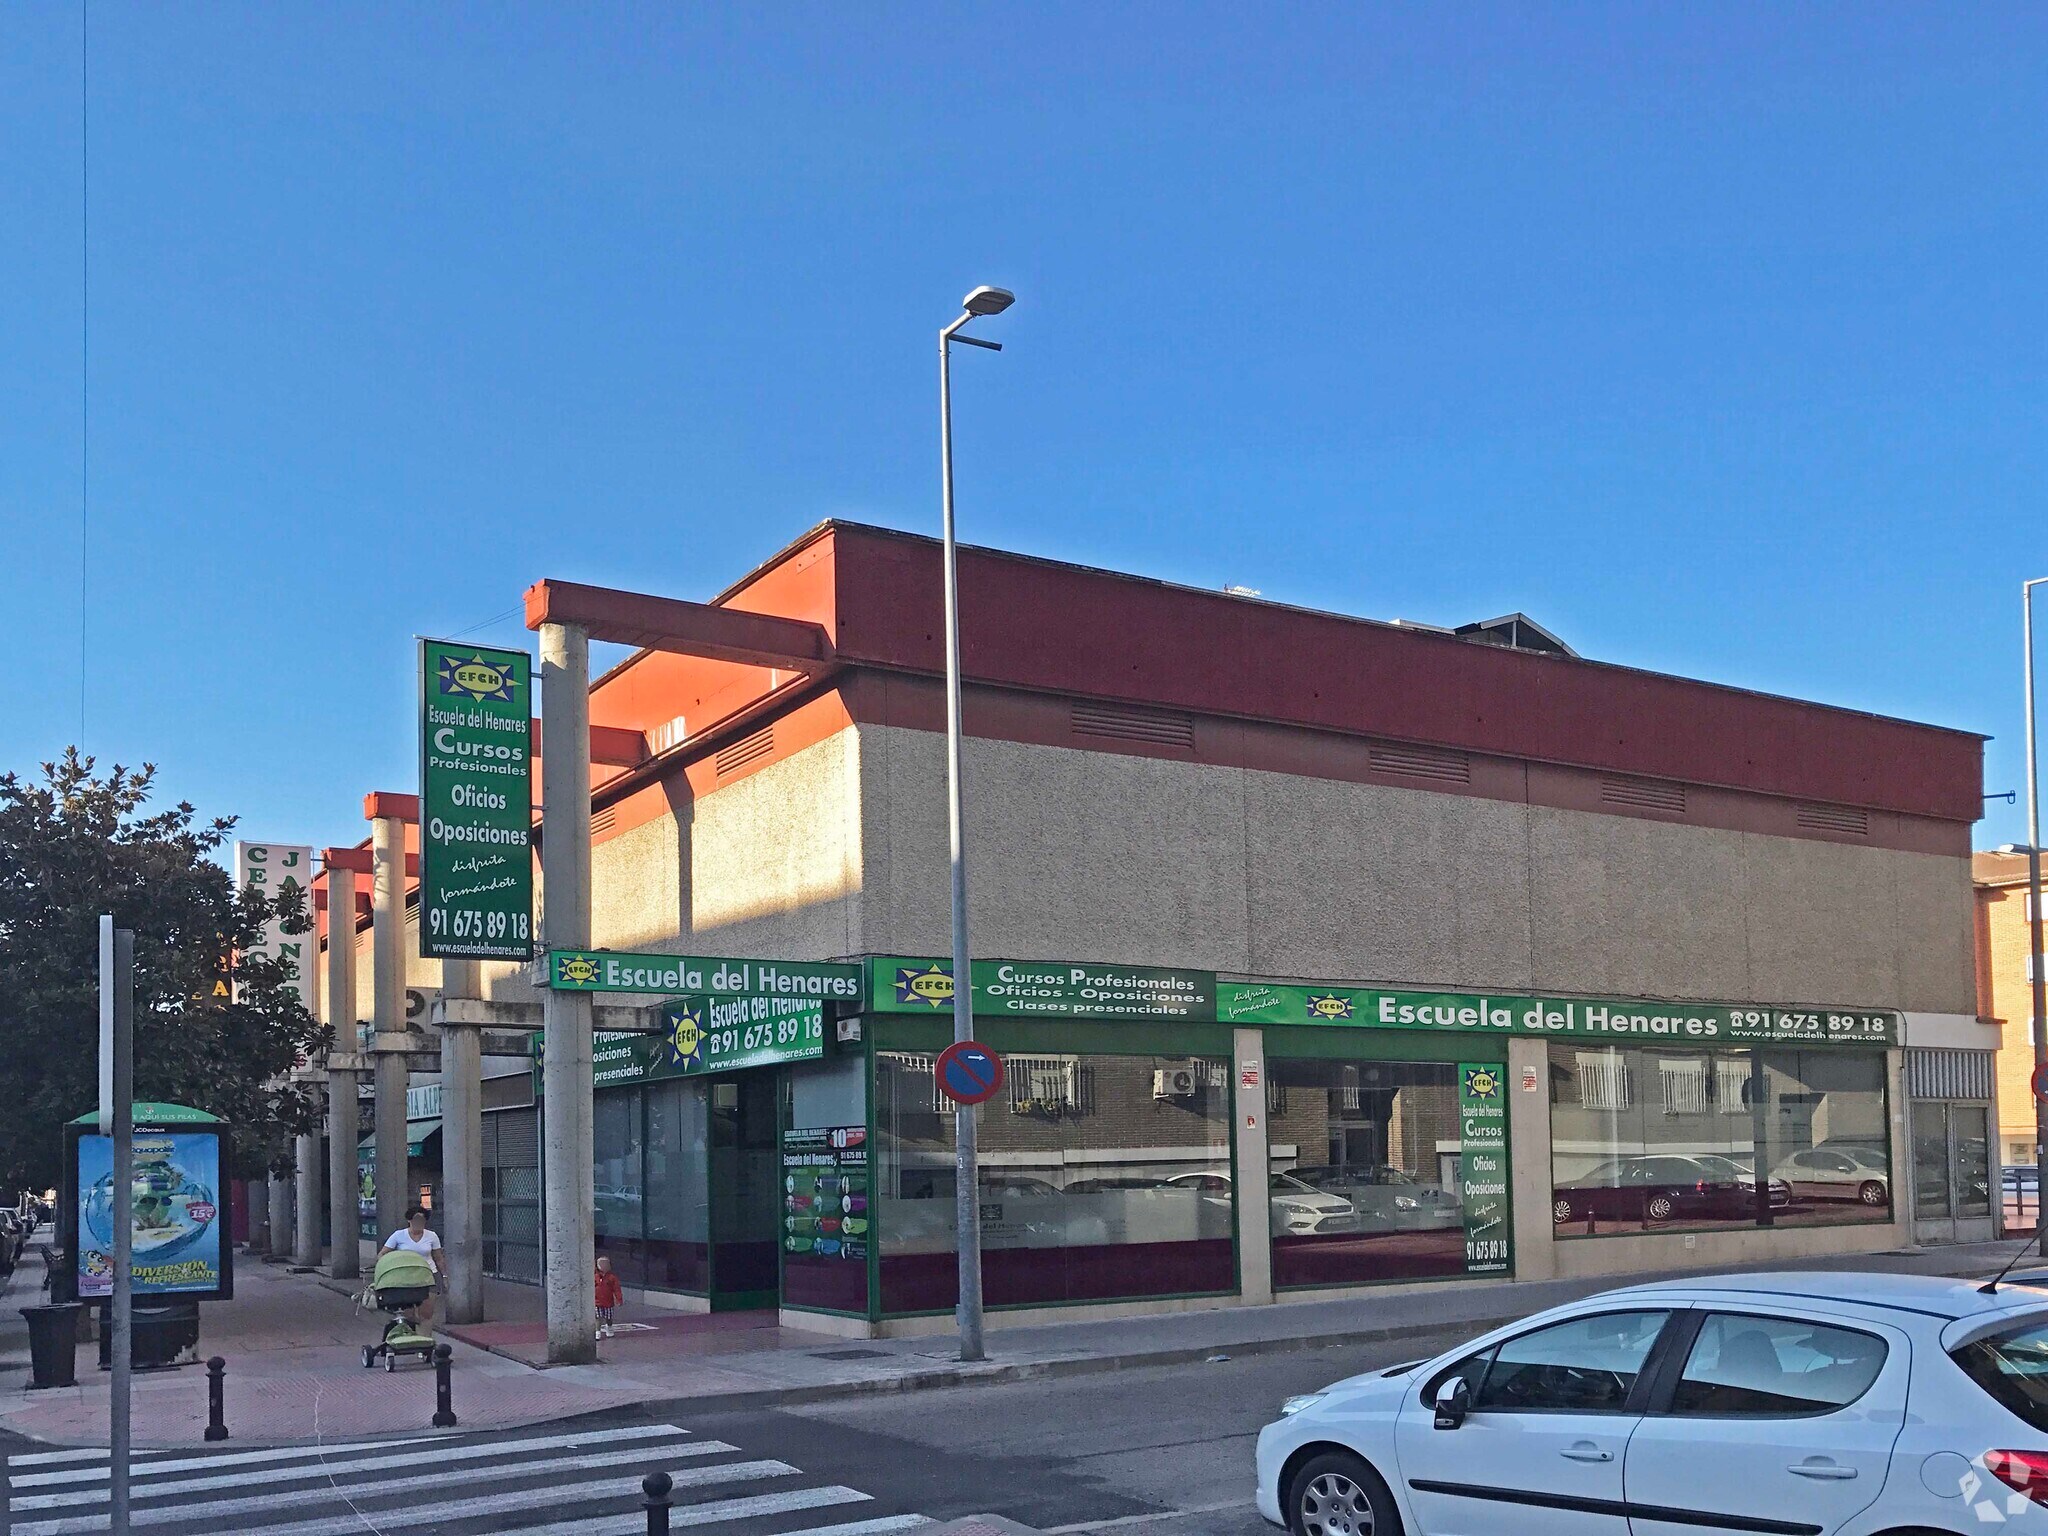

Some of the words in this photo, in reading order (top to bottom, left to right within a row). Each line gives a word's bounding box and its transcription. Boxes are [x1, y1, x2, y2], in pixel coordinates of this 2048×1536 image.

[458, 671, 499, 685] EFCH
[429, 704, 465, 726] Escuela
[467, 707, 483, 728] del
[485, 711, 527, 733] Henares
[434, 727, 523, 761] Cursos
[429, 756, 527, 776] Profesionales
[451, 784, 506, 810] Oficios
[429, 817, 528, 846] Oposiciones
[452, 854, 507, 873] disfruta
[440, 876, 517, 904] formándote
[430, 907, 448, 936] 91
[453, 909, 483, 938] 675
[486, 911, 507, 938] 89
[511, 912, 529, 940] 18
[432, 941, 527, 956] www.escueladelhenares.com
[568, 966, 591, 974] EFCH
[607, 960, 702, 989] Escuela
[712, 963, 750, 991] del
[759, 966, 858, 996] Henares
[997, 966, 1065, 986] Cursos
[1071, 969, 1195, 991] Profesionales
[986, 985, 1063, 998] Oficios
[1080, 988, 1205, 1004] Oposiciones
[1234, 987, 1271, 1001] disfruta
[709, 998, 748, 1028] Escuela
[751, 997, 769, 1020] del
[1006, 1000, 1068, 1012] Clases
[1073, 1002, 1188, 1016] presenciales
[1379, 997, 1512, 1027] Escuela
[1523, 1003, 1573, 1030] del
[1586, 1007, 1718, 1036] Henares
[1745, 1011, 1770, 1028] 91
[1779, 1013, 1820, 1030] 675
[1828, 1015, 1854, 1031] 89
[1862, 1017, 1885, 1033] 18
[678, 1028, 697, 1043] EFCH
[722, 1031, 738, 1053] 91
[744, 1024, 773, 1050] 675
[778, 1018, 798, 1043] 89
[804, 1014, 823, 1039] 18
[709, 1046, 823, 1069] www.escueladelhenares.com
[593, 1063, 643, 1084] presenciales
[1474, 1079, 1492, 1087] EFCH
[1463, 1105, 1478, 1117] Escuela
[1486, 1105, 1503, 1117] Henares
[1465, 1119, 1502, 1137] Cursos
[831, 1129, 847, 1148] 10
[1463, 1139, 1504, 1147] Profesionales
[1473, 1157, 1496, 1171] Oficios
[1465, 1180, 1505, 1199] Oposiciones
[1467, 1242, 1475, 1260] 91
[1476, 1241, 1488, 1260] 675
[1490, 1240, 1498, 1259] 89
[1500, 1240, 1507, 1258] 18
